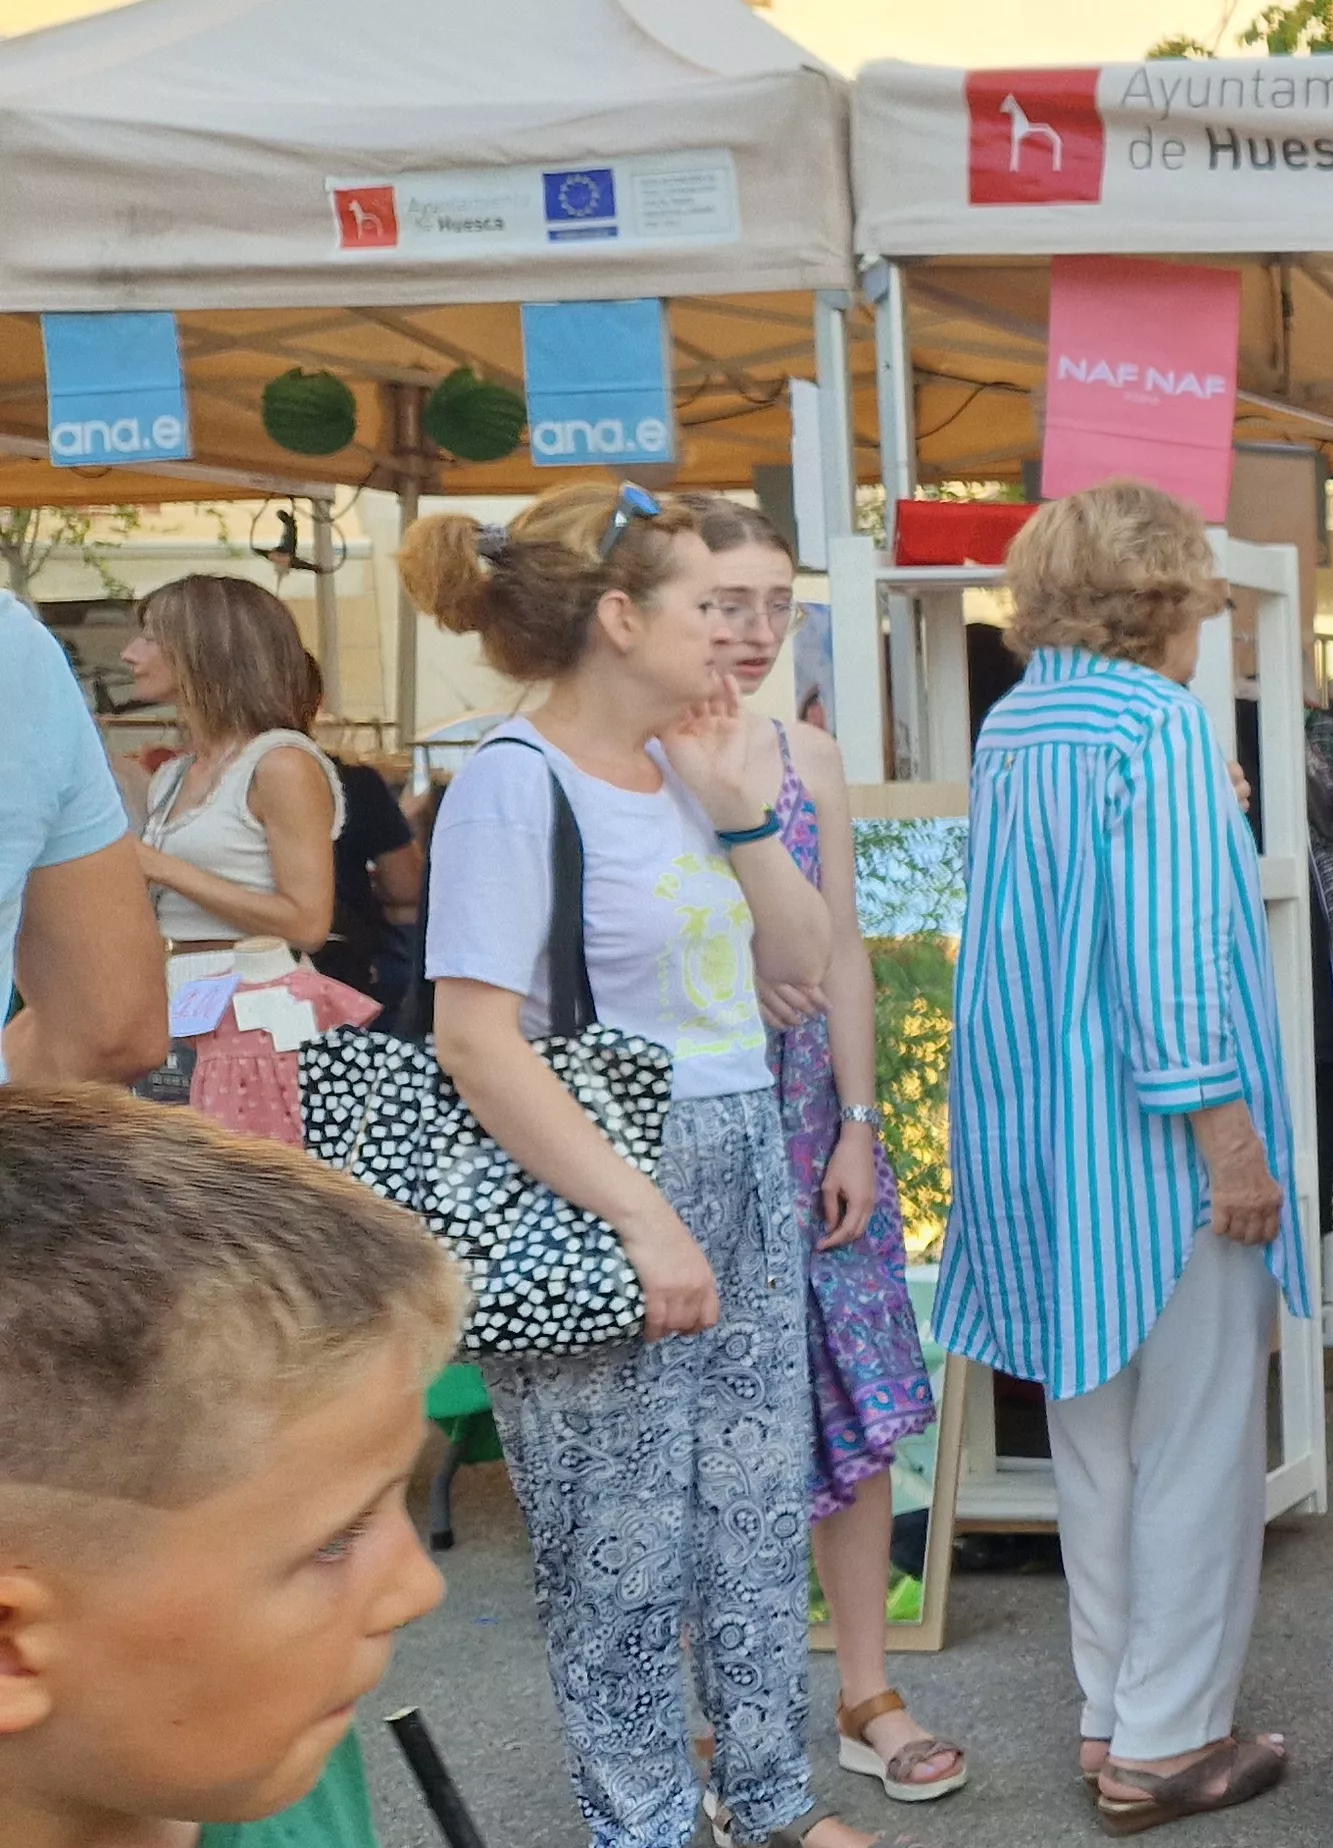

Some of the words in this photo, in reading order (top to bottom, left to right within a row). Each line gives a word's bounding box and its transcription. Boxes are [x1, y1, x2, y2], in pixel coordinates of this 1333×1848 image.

[1127, 125, 1187, 171] de
[437, 214, 506, 232] Huesca
[1057, 355, 1140, 388] NAF
[1144, 366, 1227, 400] NAF
[51, 414, 182, 456] ana.e
[532, 417, 667, 455] ana.e
